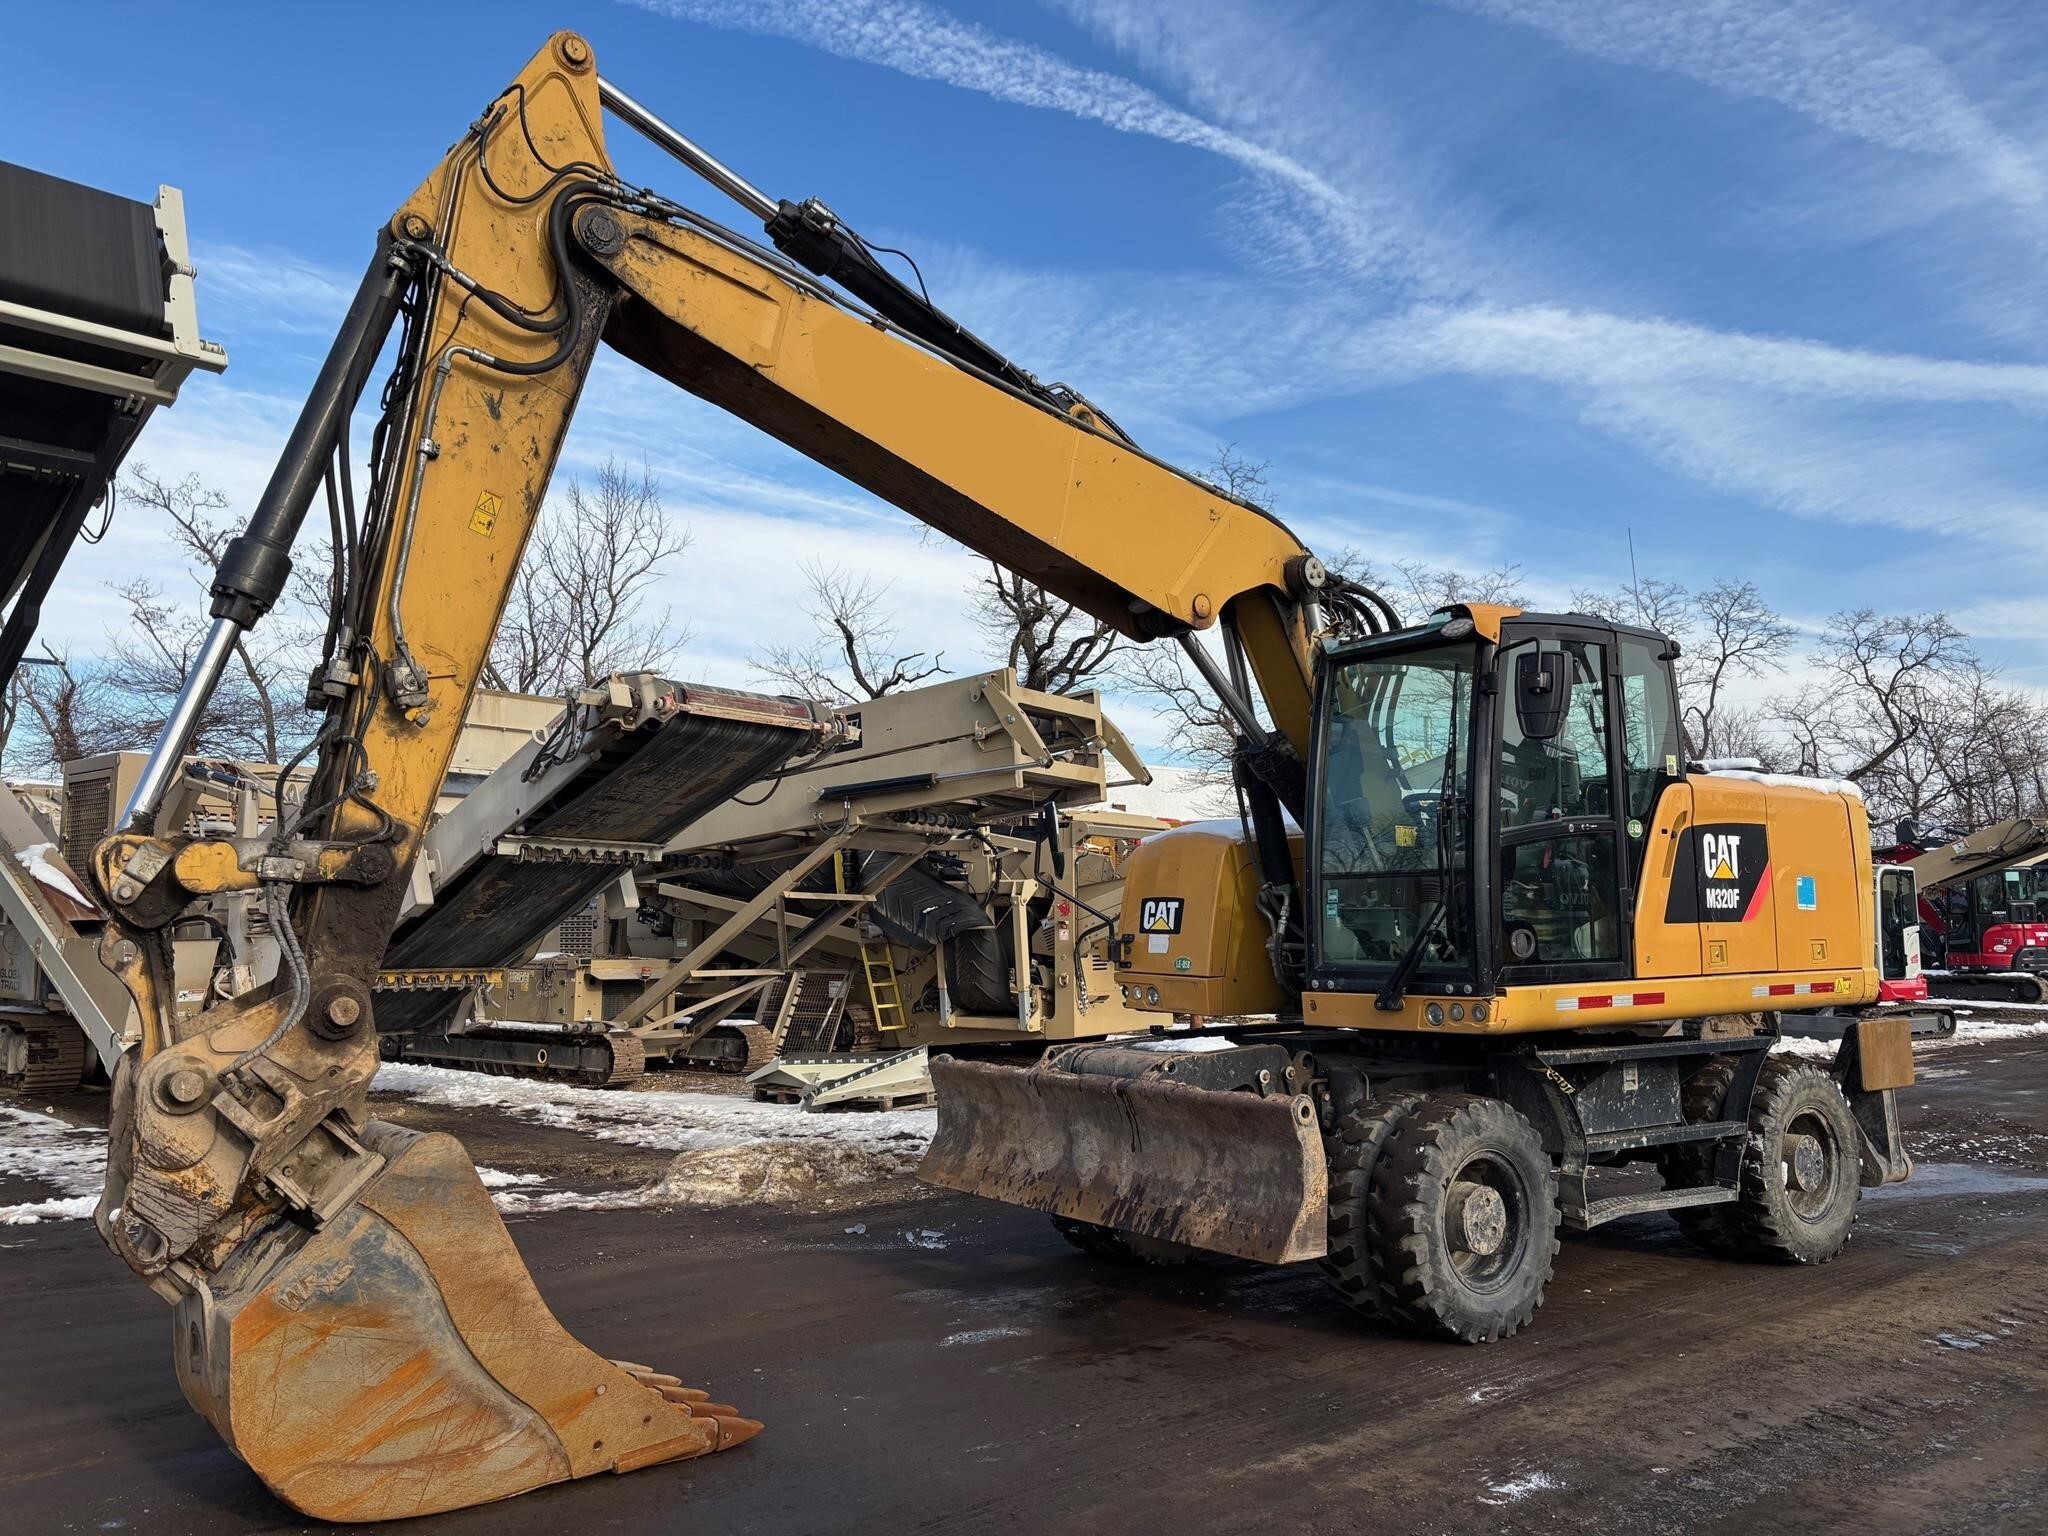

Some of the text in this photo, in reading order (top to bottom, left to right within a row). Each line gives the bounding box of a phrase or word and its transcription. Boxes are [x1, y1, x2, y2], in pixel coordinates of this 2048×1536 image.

[1703, 833, 1741, 879] CAT
[1706, 888, 1740, 909] M320F
[1143, 901, 1179, 930] CAT
